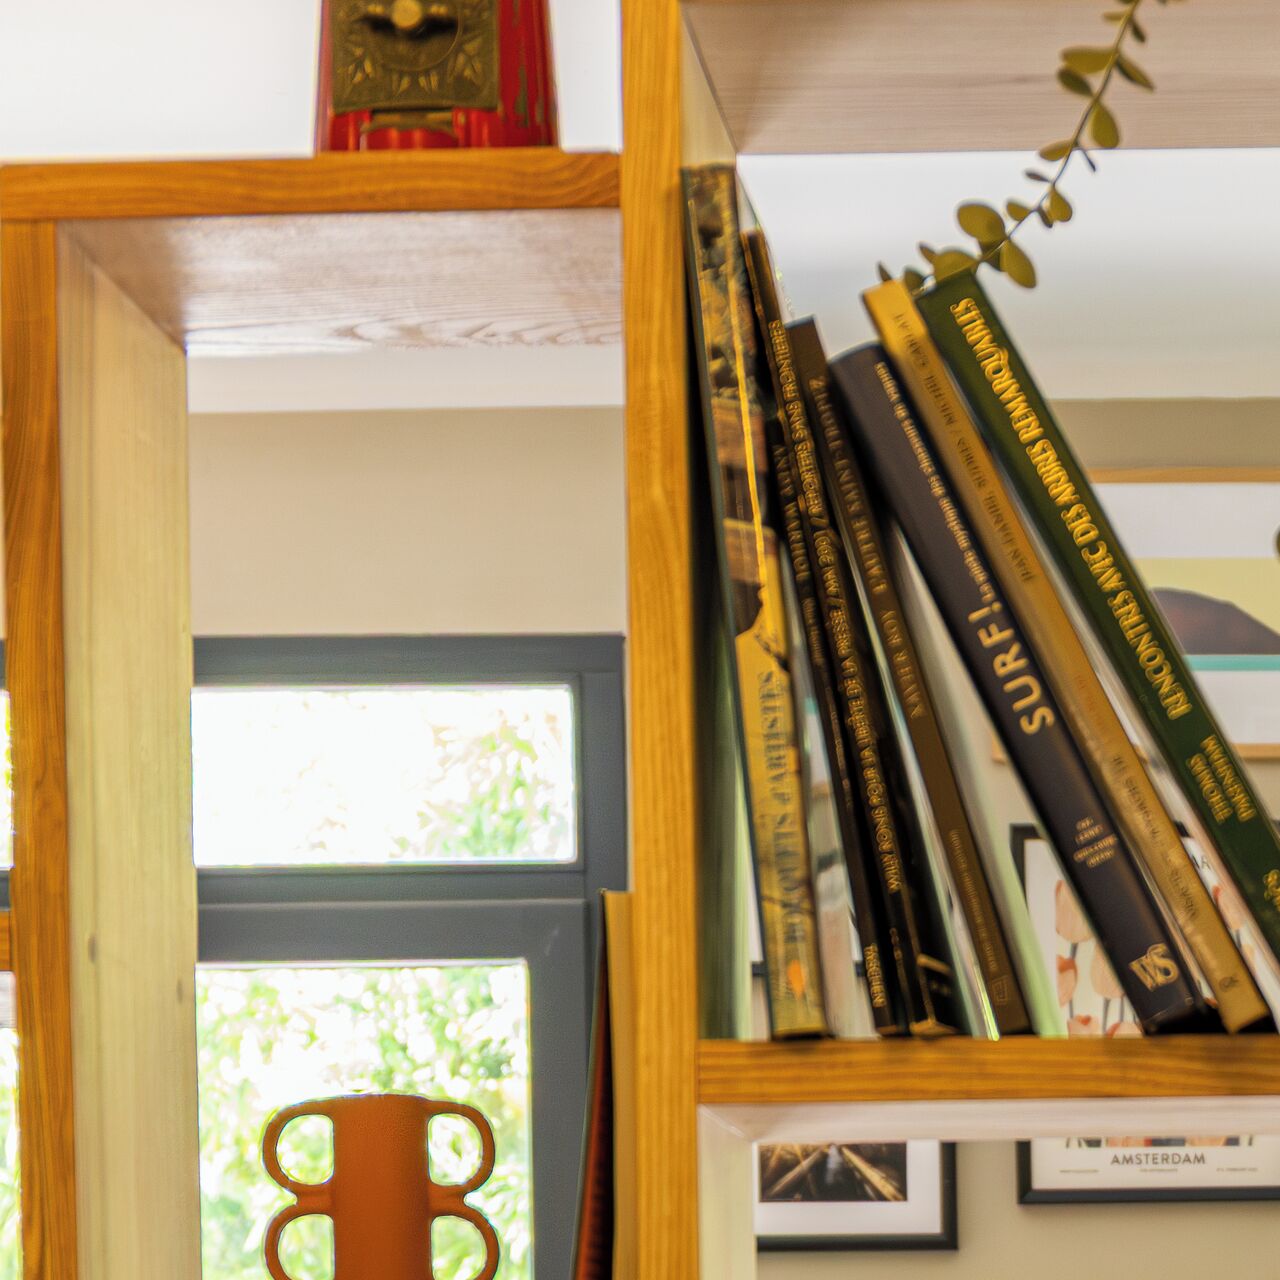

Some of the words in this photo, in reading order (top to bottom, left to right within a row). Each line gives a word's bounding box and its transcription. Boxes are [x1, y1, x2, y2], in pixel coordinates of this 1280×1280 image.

[948, 294, 1045, 444] REMARQUABLES
[1024, 436, 1079, 511] ARBRES
[1059, 501, 1100, 548] DES
[1079, 538, 1125, 595] AVEC
[1105, 588, 1192, 721] RENCONTRES
[1110, 1152, 1206, 1166] AMSTERDAM
